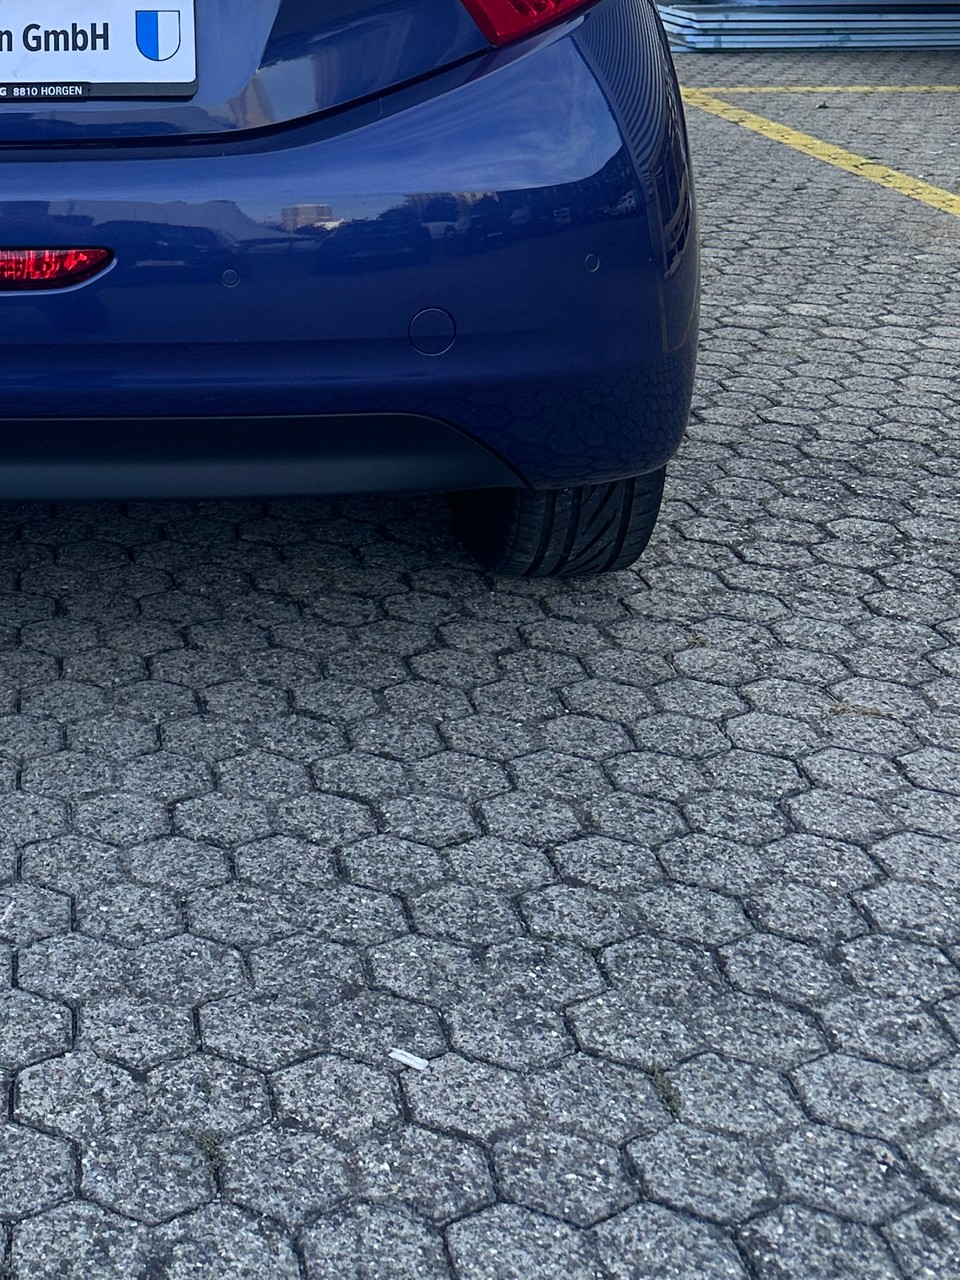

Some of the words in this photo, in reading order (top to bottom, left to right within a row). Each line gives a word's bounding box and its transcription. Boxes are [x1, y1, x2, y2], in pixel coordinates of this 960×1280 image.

[22, 22, 110, 52] GmbH
[13, 86, 38, 96] 8810
[40, 85, 83, 96] HORGEN
